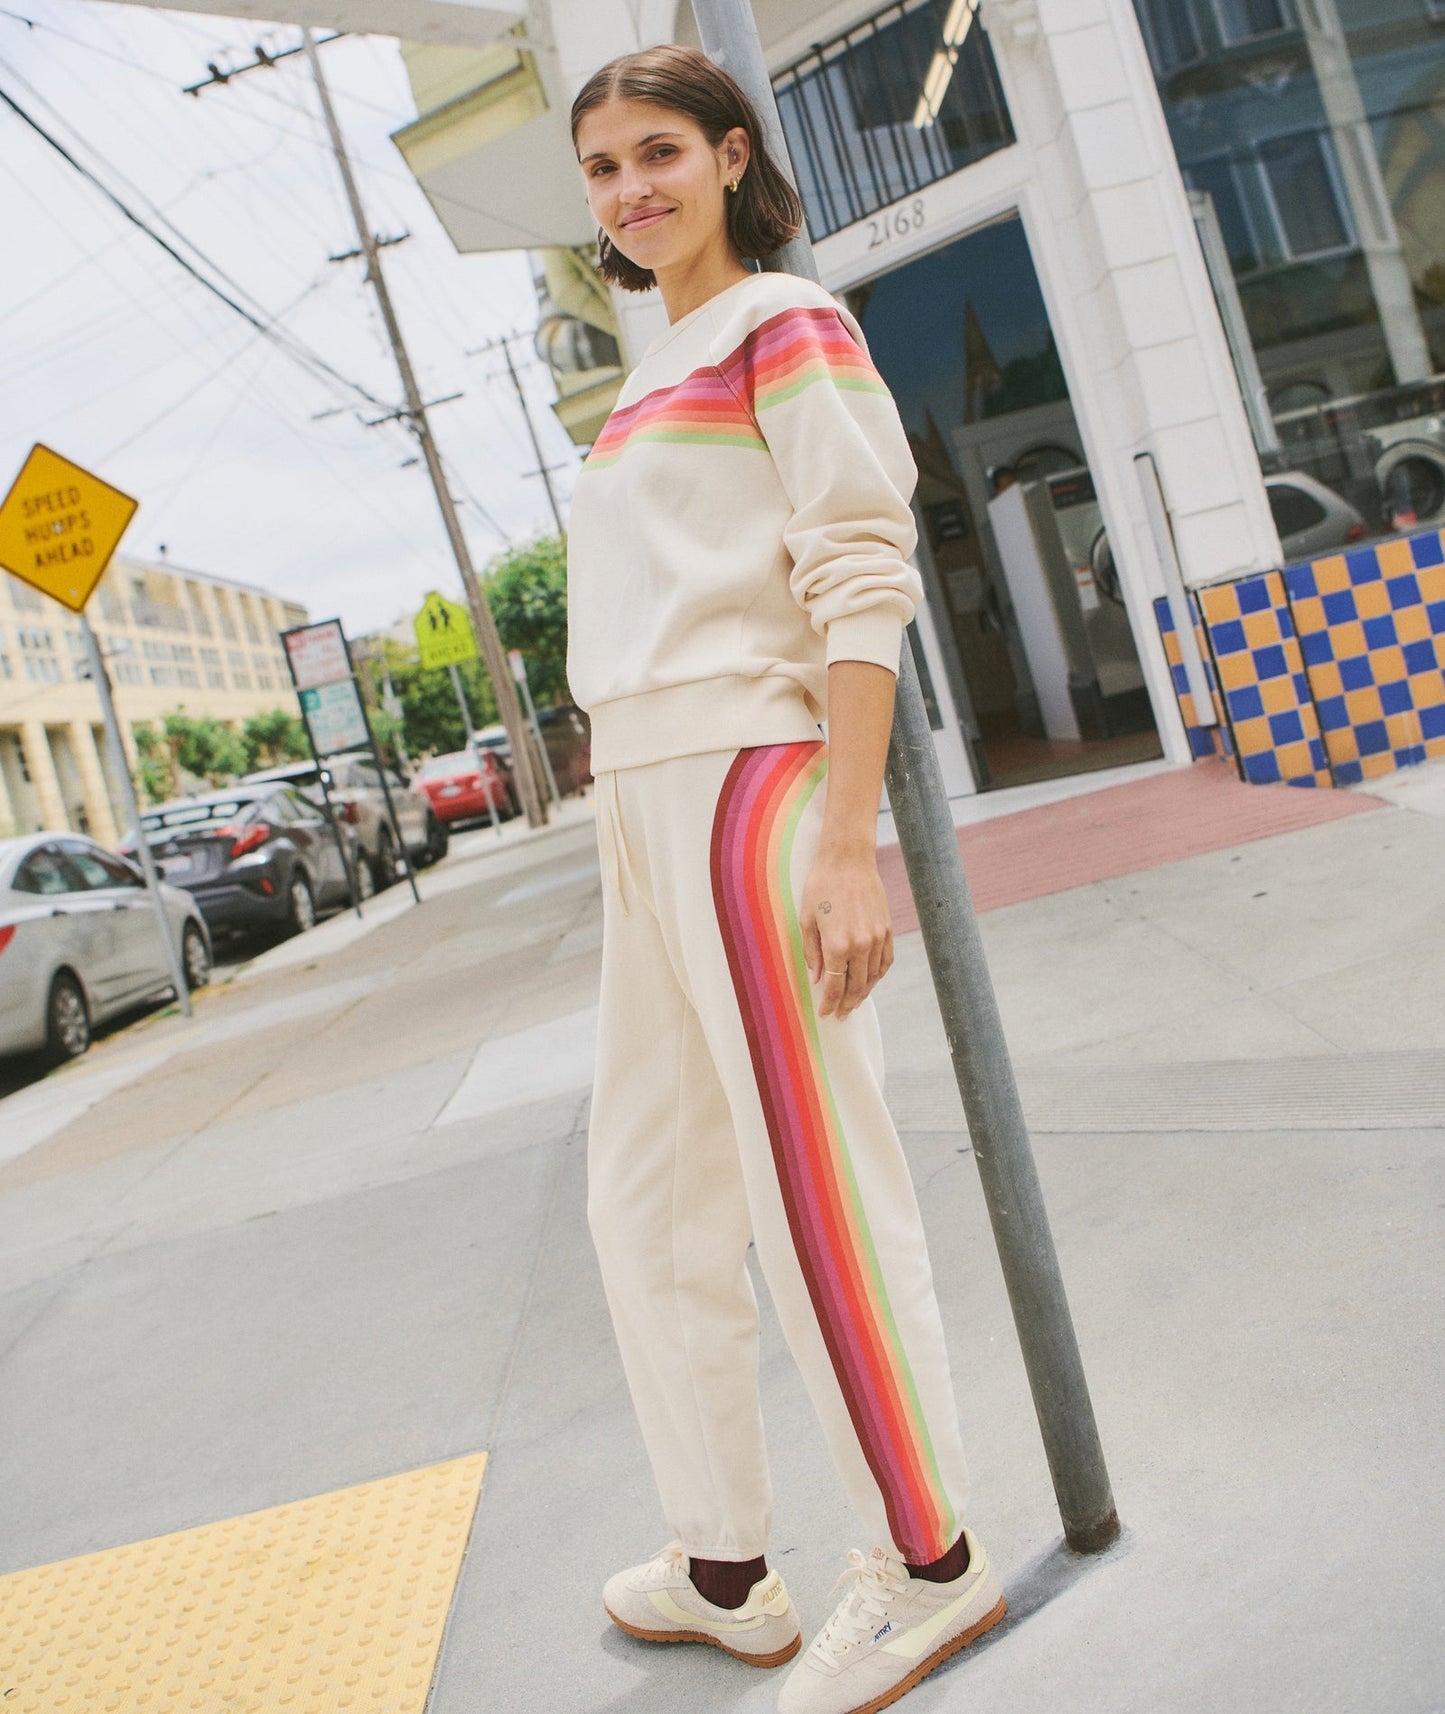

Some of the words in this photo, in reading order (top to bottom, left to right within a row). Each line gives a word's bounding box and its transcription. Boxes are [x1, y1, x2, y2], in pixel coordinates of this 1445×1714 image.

[867, 199, 925, 250] 2168
[23, 487, 81, 517] SPEED
[35, 537, 94, 567] AHEAD
